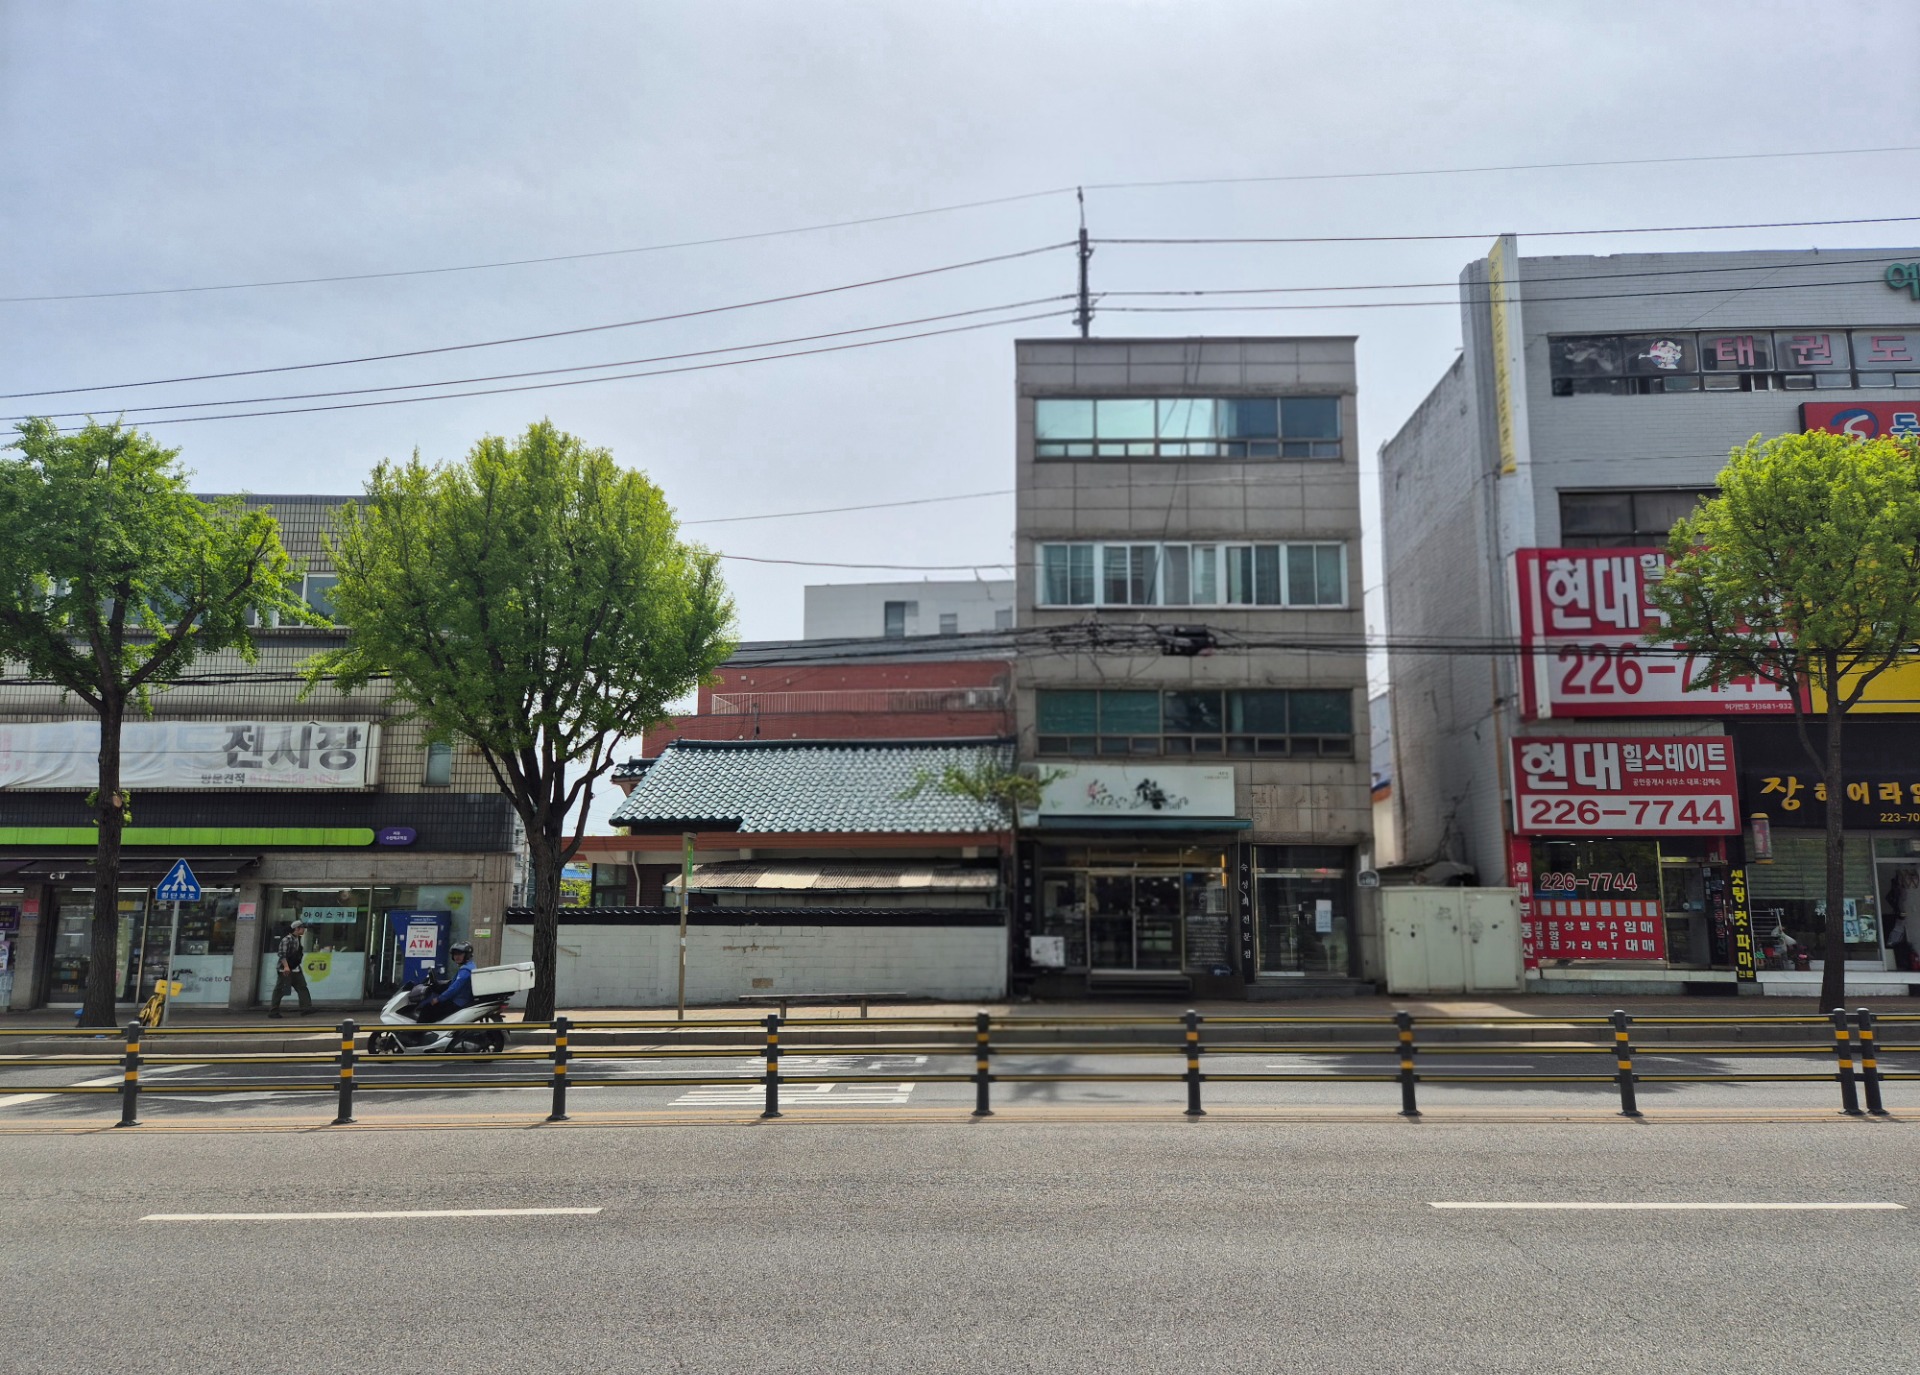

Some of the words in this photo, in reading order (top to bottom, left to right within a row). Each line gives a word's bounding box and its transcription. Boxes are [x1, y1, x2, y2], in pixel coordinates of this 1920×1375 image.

[1716, 334, 1912, 367] 태권도
[1546, 557, 1640, 630] 현대
[223, 726, 361, 770] 전시장
[201, 772, 246, 785] 방문견적
[1521, 742, 1622, 790] 현대
[1623, 743, 1728, 773] 힐스테이트
[1633, 777, 1665, 787] 공인중개사
[1665, 777, 1686, 787] 사무소
[1530, 799, 1726, 826] 226-7744
[1540, 872, 1638, 892] 226-7744
[303, 911, 355, 919] 아이스커피
[409, 939, 434, 949] ATM
[1548, 921, 1560, 950] 분양권
[1563, 921, 1576, 950] 상가
[1579, 921, 1592, 950] 빌라
[1596, 921, 1608, 950] 주택
[1609, 921, 1619, 950] APT
[1623, 921, 1639, 951] 임대
[1640, 921, 1656, 952] 매매
